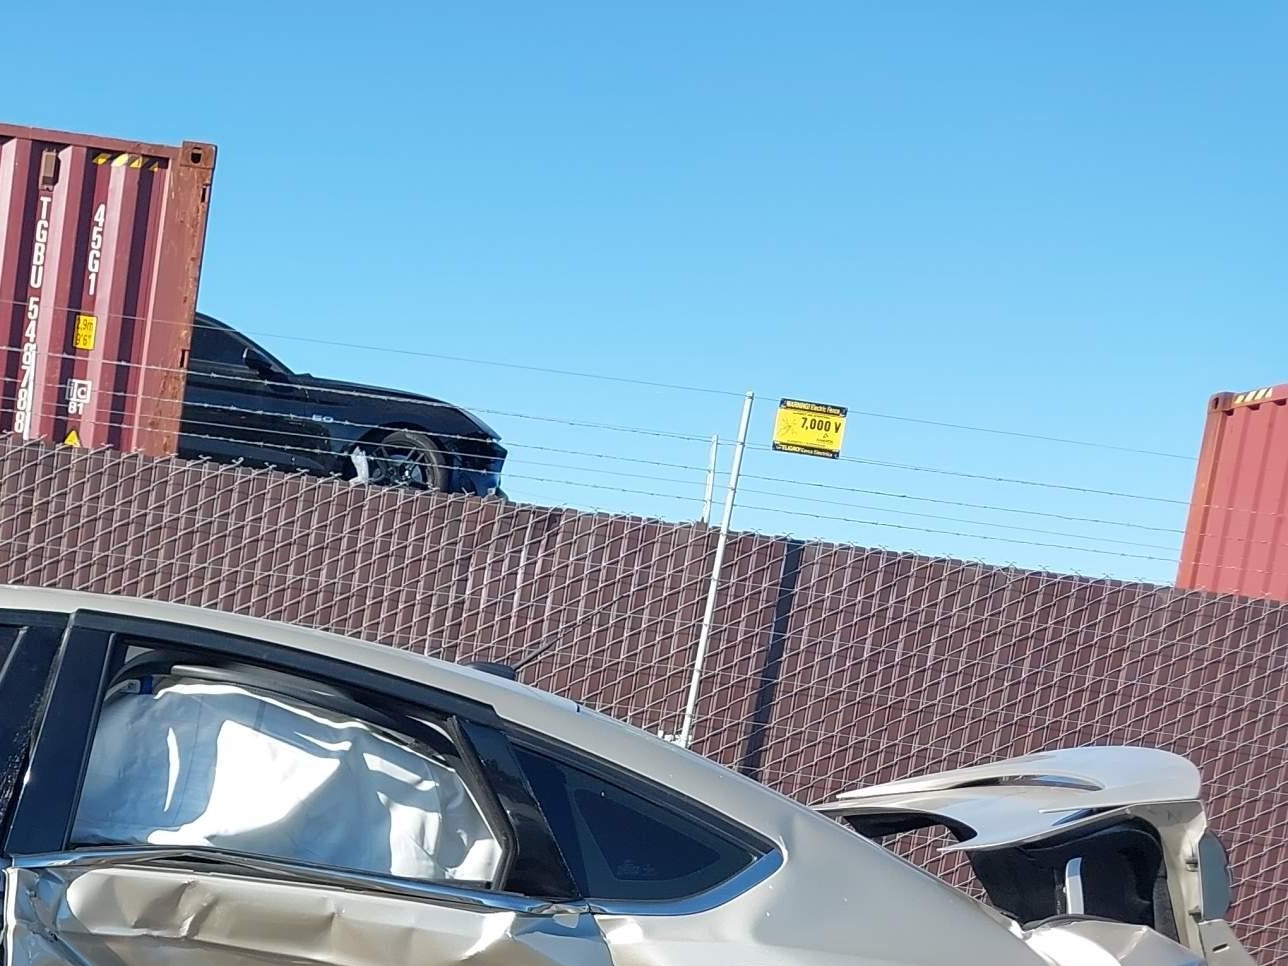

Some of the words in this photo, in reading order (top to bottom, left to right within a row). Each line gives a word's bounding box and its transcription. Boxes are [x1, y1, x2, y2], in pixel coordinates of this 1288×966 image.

[87, 203, 107, 296] 45G1
[801, 417, 831, 432] 7,000
[834, 421, 842, 434] V
